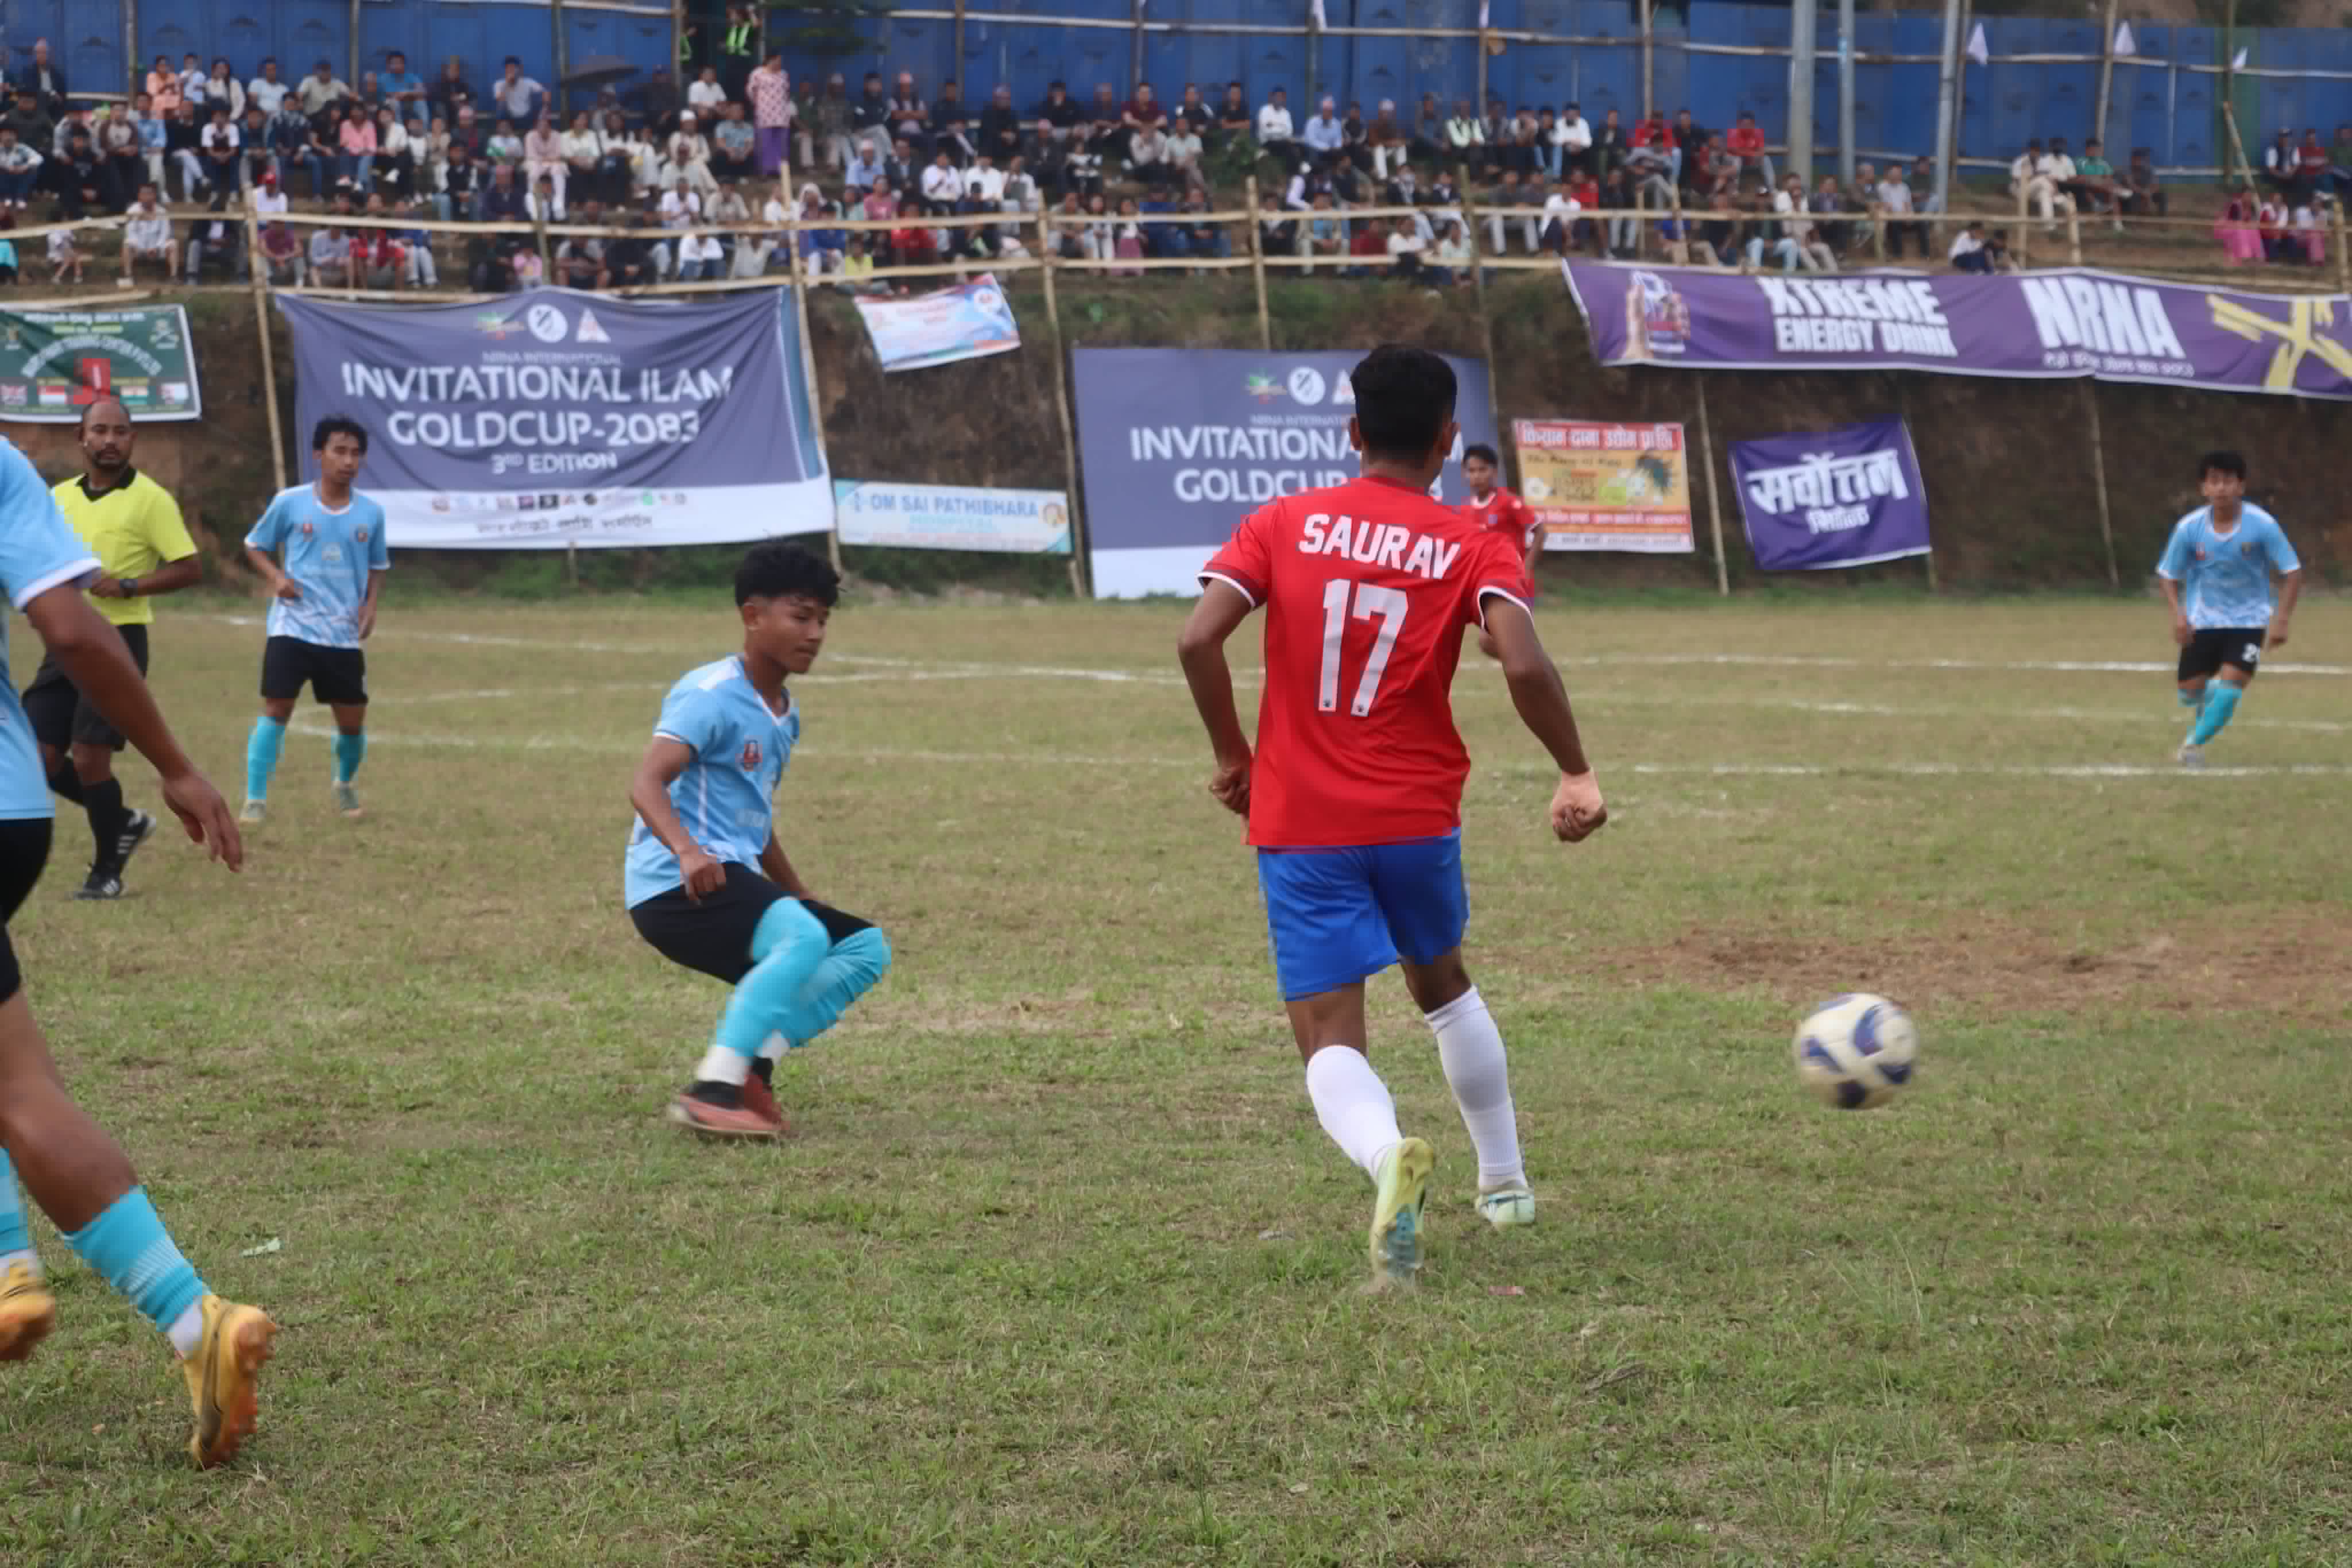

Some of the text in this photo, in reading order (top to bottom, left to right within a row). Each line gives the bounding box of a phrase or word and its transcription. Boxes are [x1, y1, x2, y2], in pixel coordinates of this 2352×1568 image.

[1756, 276, 1947, 326] XTREME
[2020, 276, 2186, 359] NRNA
[1773, 315, 1959, 358] ENERGY DRINK
[341, 362, 734, 402] INVITATIONAL ILAM
[386, 409, 700, 447] GOLDCUP-2083
[1129, 425, 1361, 461] INVITATIONA
[528, 451, 618, 474] EDITION
[870, 492, 1039, 516] OM SAI PATHIBHARA
[1298, 513, 1461, 580] SAURAV
[1318, 578, 1409, 718] 17
